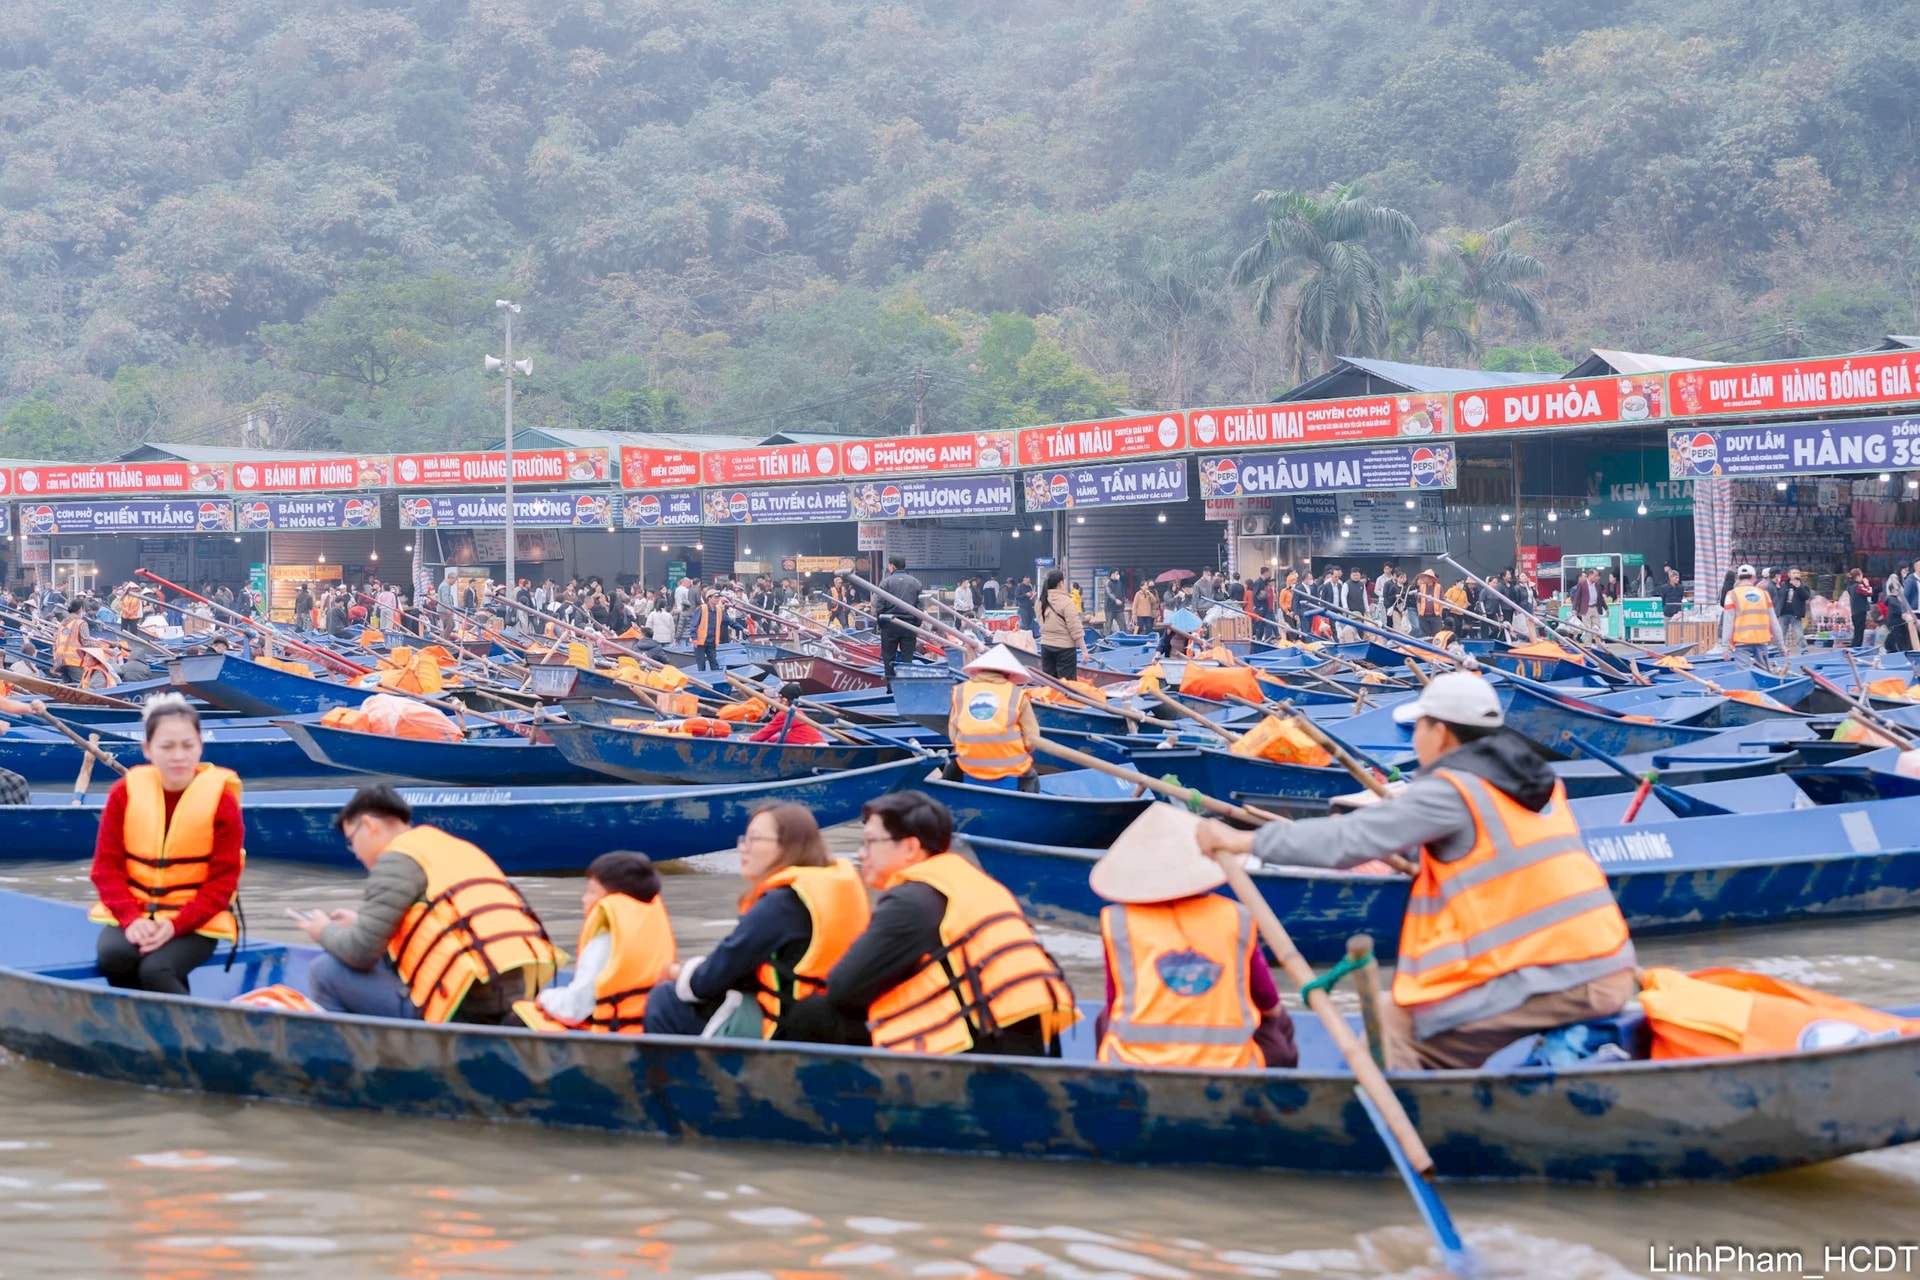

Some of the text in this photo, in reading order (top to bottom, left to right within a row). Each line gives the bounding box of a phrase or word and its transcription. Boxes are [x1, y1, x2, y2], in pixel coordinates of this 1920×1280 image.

[1709, 379, 1738, 400] DUY
[1741, 373, 1774, 398] LÂM
[1782, 368, 1827, 403] HÀNG
[1881, 359, 1912, 396] GIÁ
[1306, 401, 1391, 421] CHUYÊN CƠM PHỞ
[1504, 384, 1602, 423] DU HÒA
[1224, 409, 1304, 442] CHÂU MAI
[1047, 427, 1075, 457] TẤN
[1726, 430, 1785, 452] DUY LÂM
[1793, 429, 1887, 466] HÀNG
[424, 456, 460, 469] NHÀ HÀNG
[758, 449, 810, 475] TIẾN HÀ
[874, 445, 972, 466] PHƯƠNG ANH
[1692, 448, 1716, 458] PEPSI
[265, 464, 296, 487] BÁNH
[320, 462, 353, 485] NÓNG
[463, 455, 508, 480] QUẢNG
[1217, 472, 1237, 480] PEPSI
[1242, 457, 1309, 491] CHÂU
[1314, 459, 1361, 488] MAI
[1413, 462, 1436, 471] PEPSI
[71, 467, 104, 489] CHIẾN
[107, 465, 142, 488] THẮNG
[1079, 471, 1094, 483] CỬA
[1101, 468, 1137, 493] TẤN
[904, 487, 1012, 508] PHƯƠNG ANH
[1077, 485, 1098, 496] HÀNG
[1610, 483, 1650, 501] KEM
[279, 501, 313, 514] BÁNH
[439, 499, 451, 507] NHÀ
[458, 498, 507, 517] QUẢNG
[751, 498, 767, 511] BA
[807, 492, 823, 509] CÀ
[825, 491, 847, 508] PHÊ
[94, 505, 138, 524] CHIẾN
[142, 504, 194, 524] THẮNG
[289, 515, 326, 527] NÓNG
[437, 508, 454, 516] HÀNG
